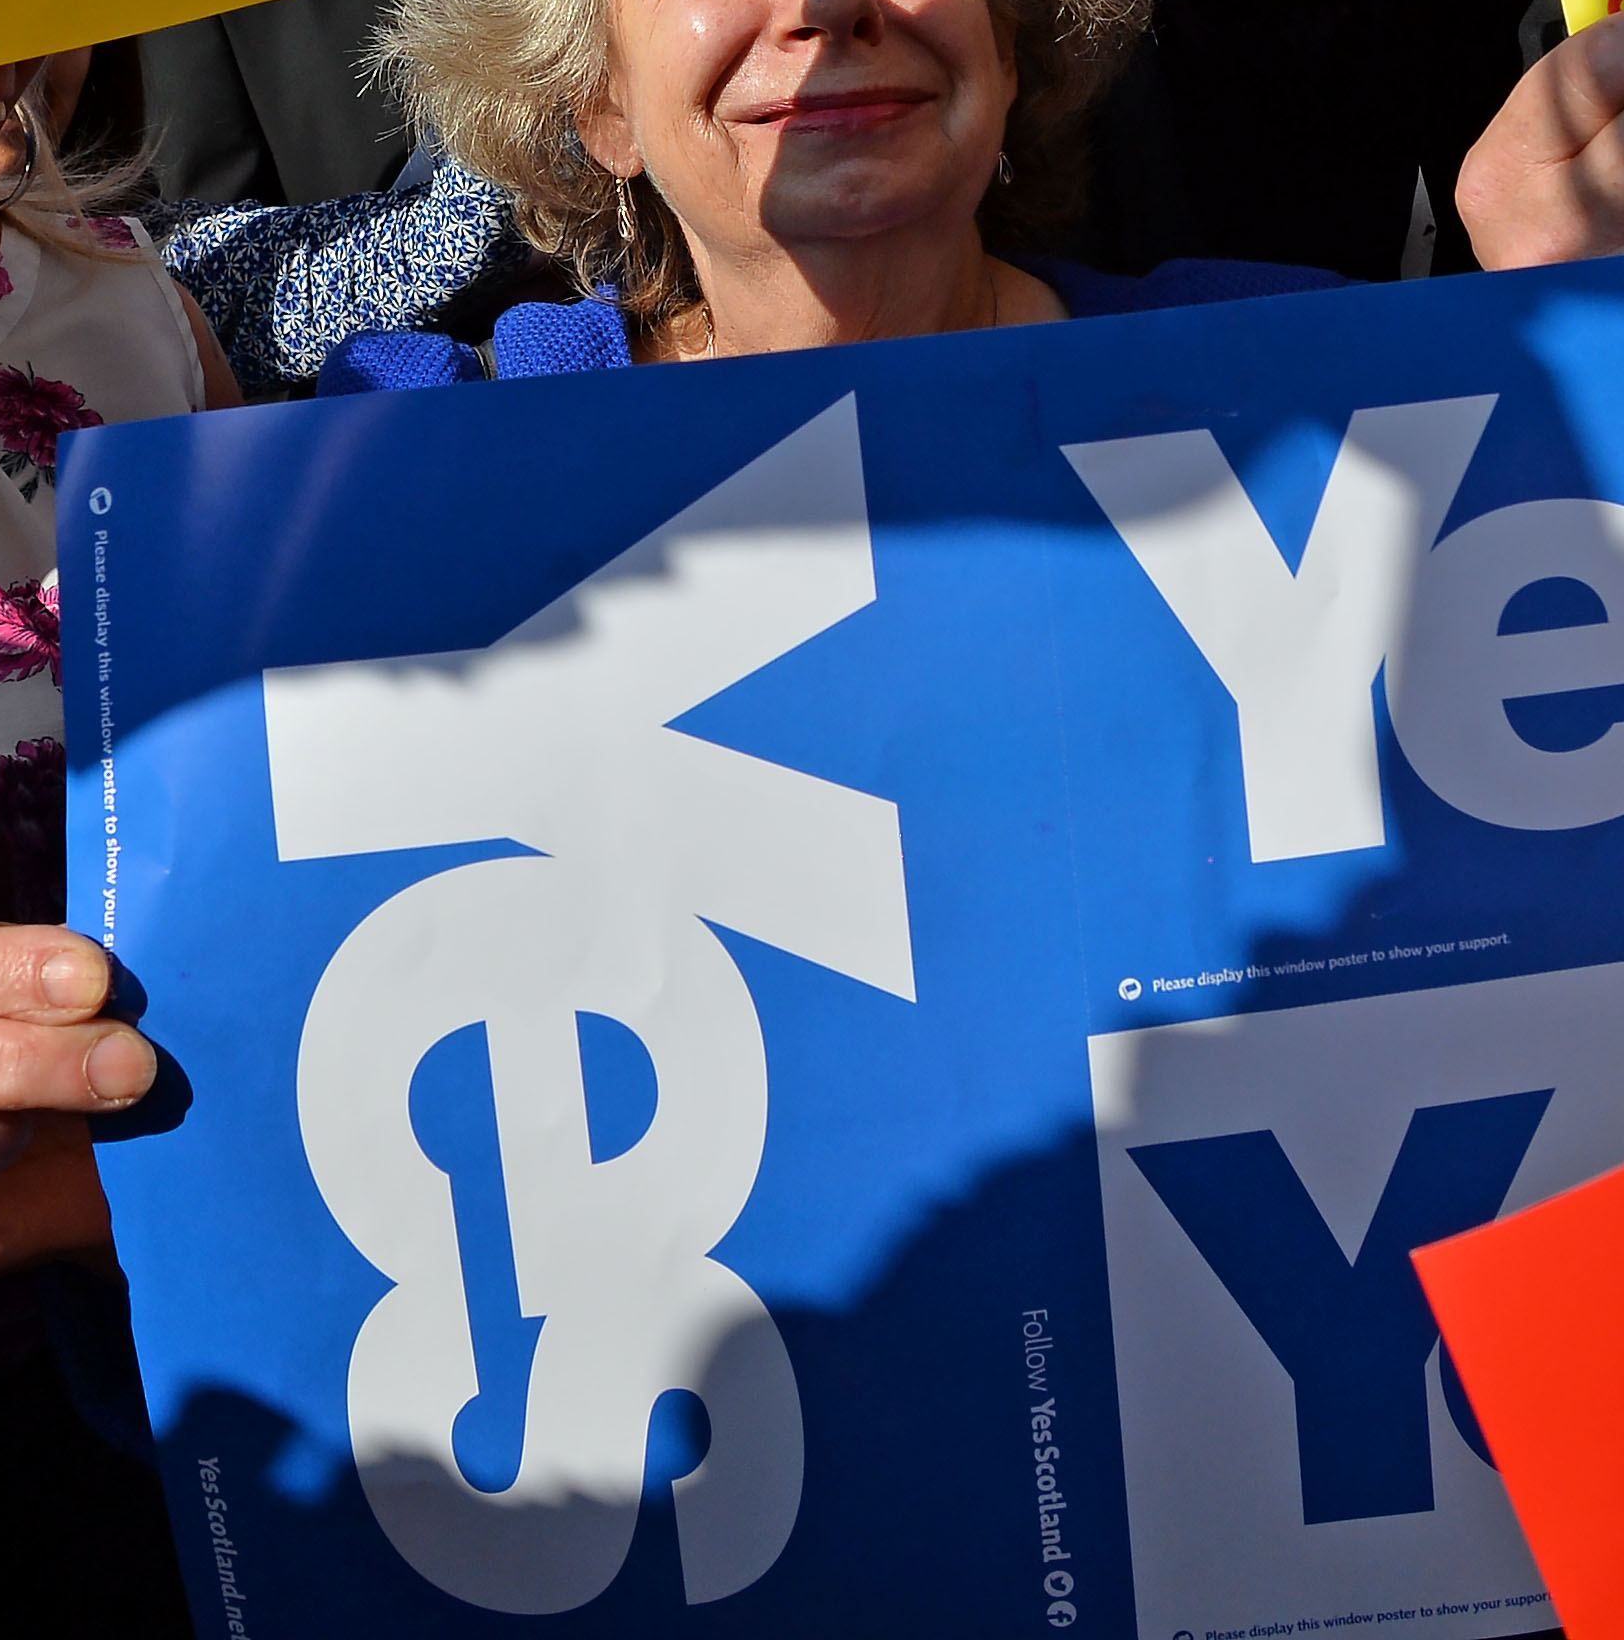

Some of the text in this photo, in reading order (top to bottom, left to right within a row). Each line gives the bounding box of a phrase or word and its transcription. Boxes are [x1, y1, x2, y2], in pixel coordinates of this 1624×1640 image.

[94, 529, 109, 583] Please
[94, 587, 112, 647] display
[98, 651, 113, 682] this
[99, 686, 116, 754] window
[100, 758, 118, 812] poster
[104, 815, 119, 835] to
[106, 837, 122, 886] show
[102, 886, 117, 930] your
[1152, 932, 1512, 993] Please display this window poster to show your support.
[263, 390, 917, 1616] Yes
[1022, 1309, 1055, 1391] Follow
[1205, 1626, 1246, 1640] Please
[1249, 1621, 1295, 1640] display
[1297, 1616, 1321, 1632] this
[1323, 1610, 1374, 1629] window
[1376, 1607, 1417, 1624] poster
[1420, 1605, 1434, 1618] to
[1436, 1600, 1470, 1616] show
[1472, 1596, 1503, 1615] your
